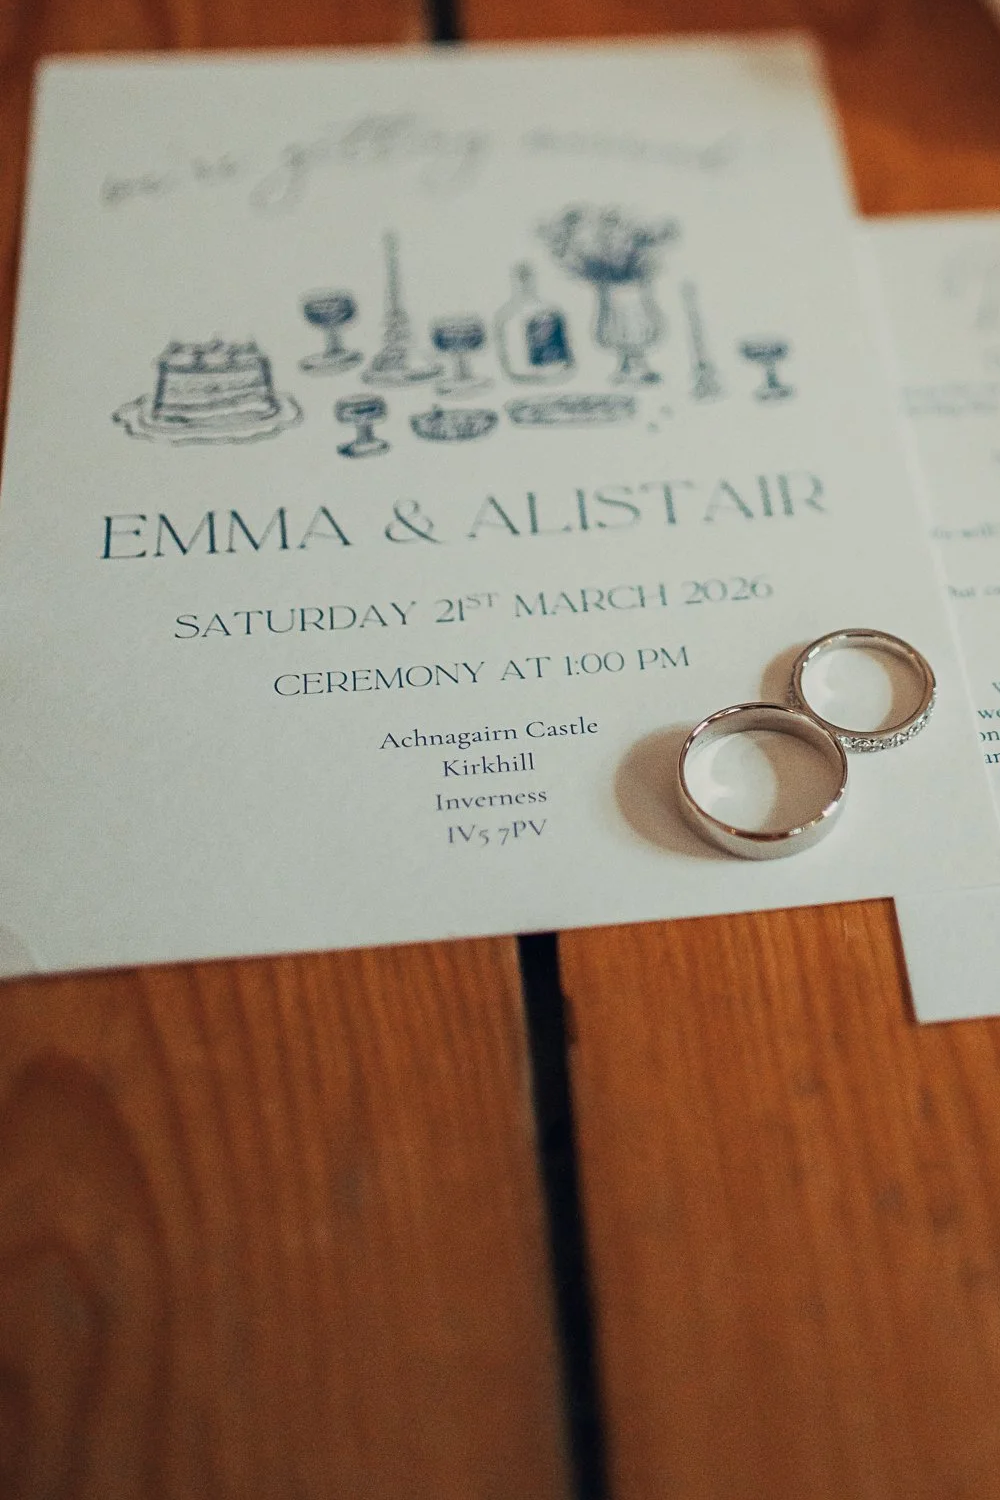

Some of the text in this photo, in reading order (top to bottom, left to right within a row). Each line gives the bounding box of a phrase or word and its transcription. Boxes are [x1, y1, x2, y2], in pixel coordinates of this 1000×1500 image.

[100, 470, 829, 559] EMMA & ALISTAIR
[174, 574, 775, 639] SATURDAY 21ST MARCH 2026
[274, 646, 690, 696] CEREMONY AT 1:00 PM
[379, 716, 599, 750] Achnagairn Castle
[442, 752, 535, 777] Kirkhill
[436, 790, 548, 811] Inverness
[447, 818, 548, 846] IV5 7PV
